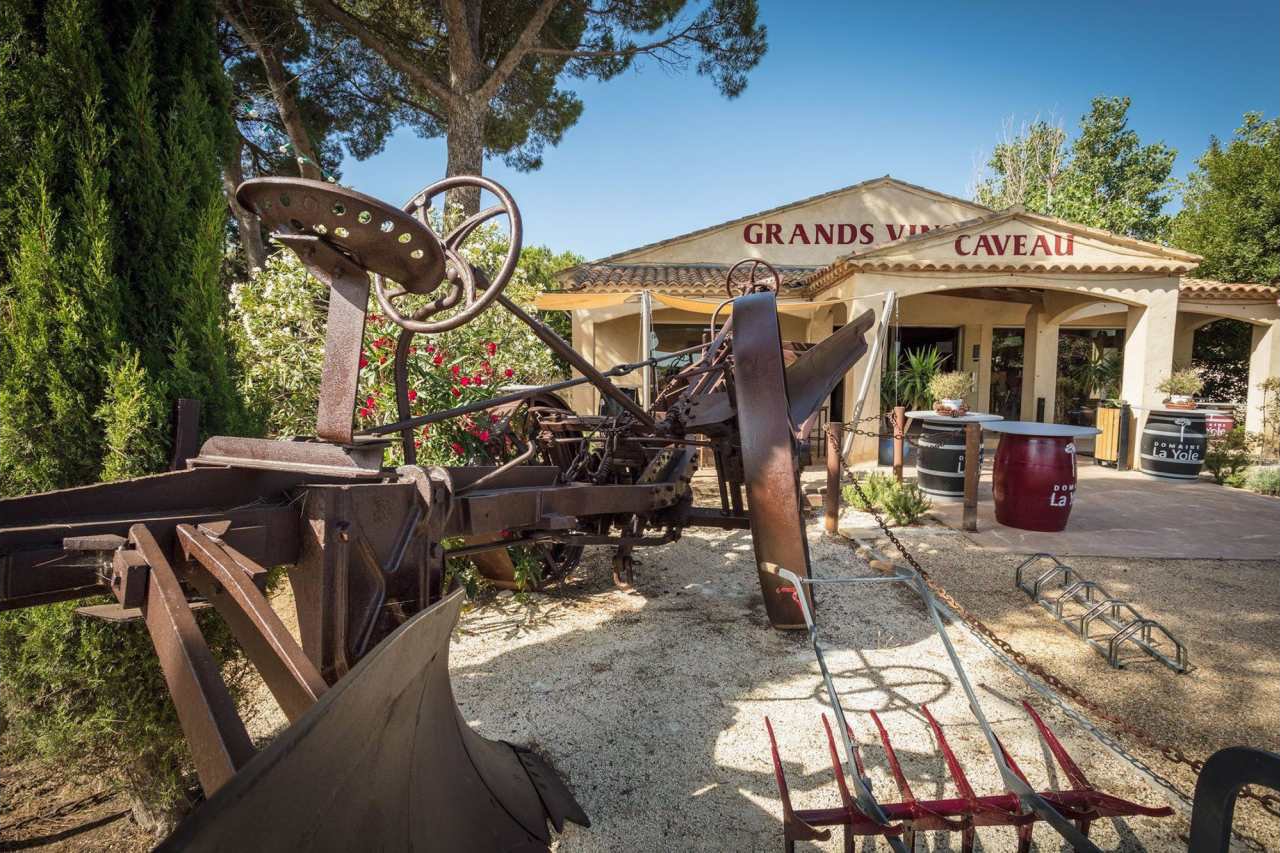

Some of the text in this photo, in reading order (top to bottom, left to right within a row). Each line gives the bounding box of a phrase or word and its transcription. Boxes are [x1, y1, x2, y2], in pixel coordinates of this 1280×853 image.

[743, 223, 875, 245] GRANDS
[954, 234, 1074, 256] CAVEAU
[1152, 446, 1199, 461] La Yole
[1050, 492, 1067, 507] La
